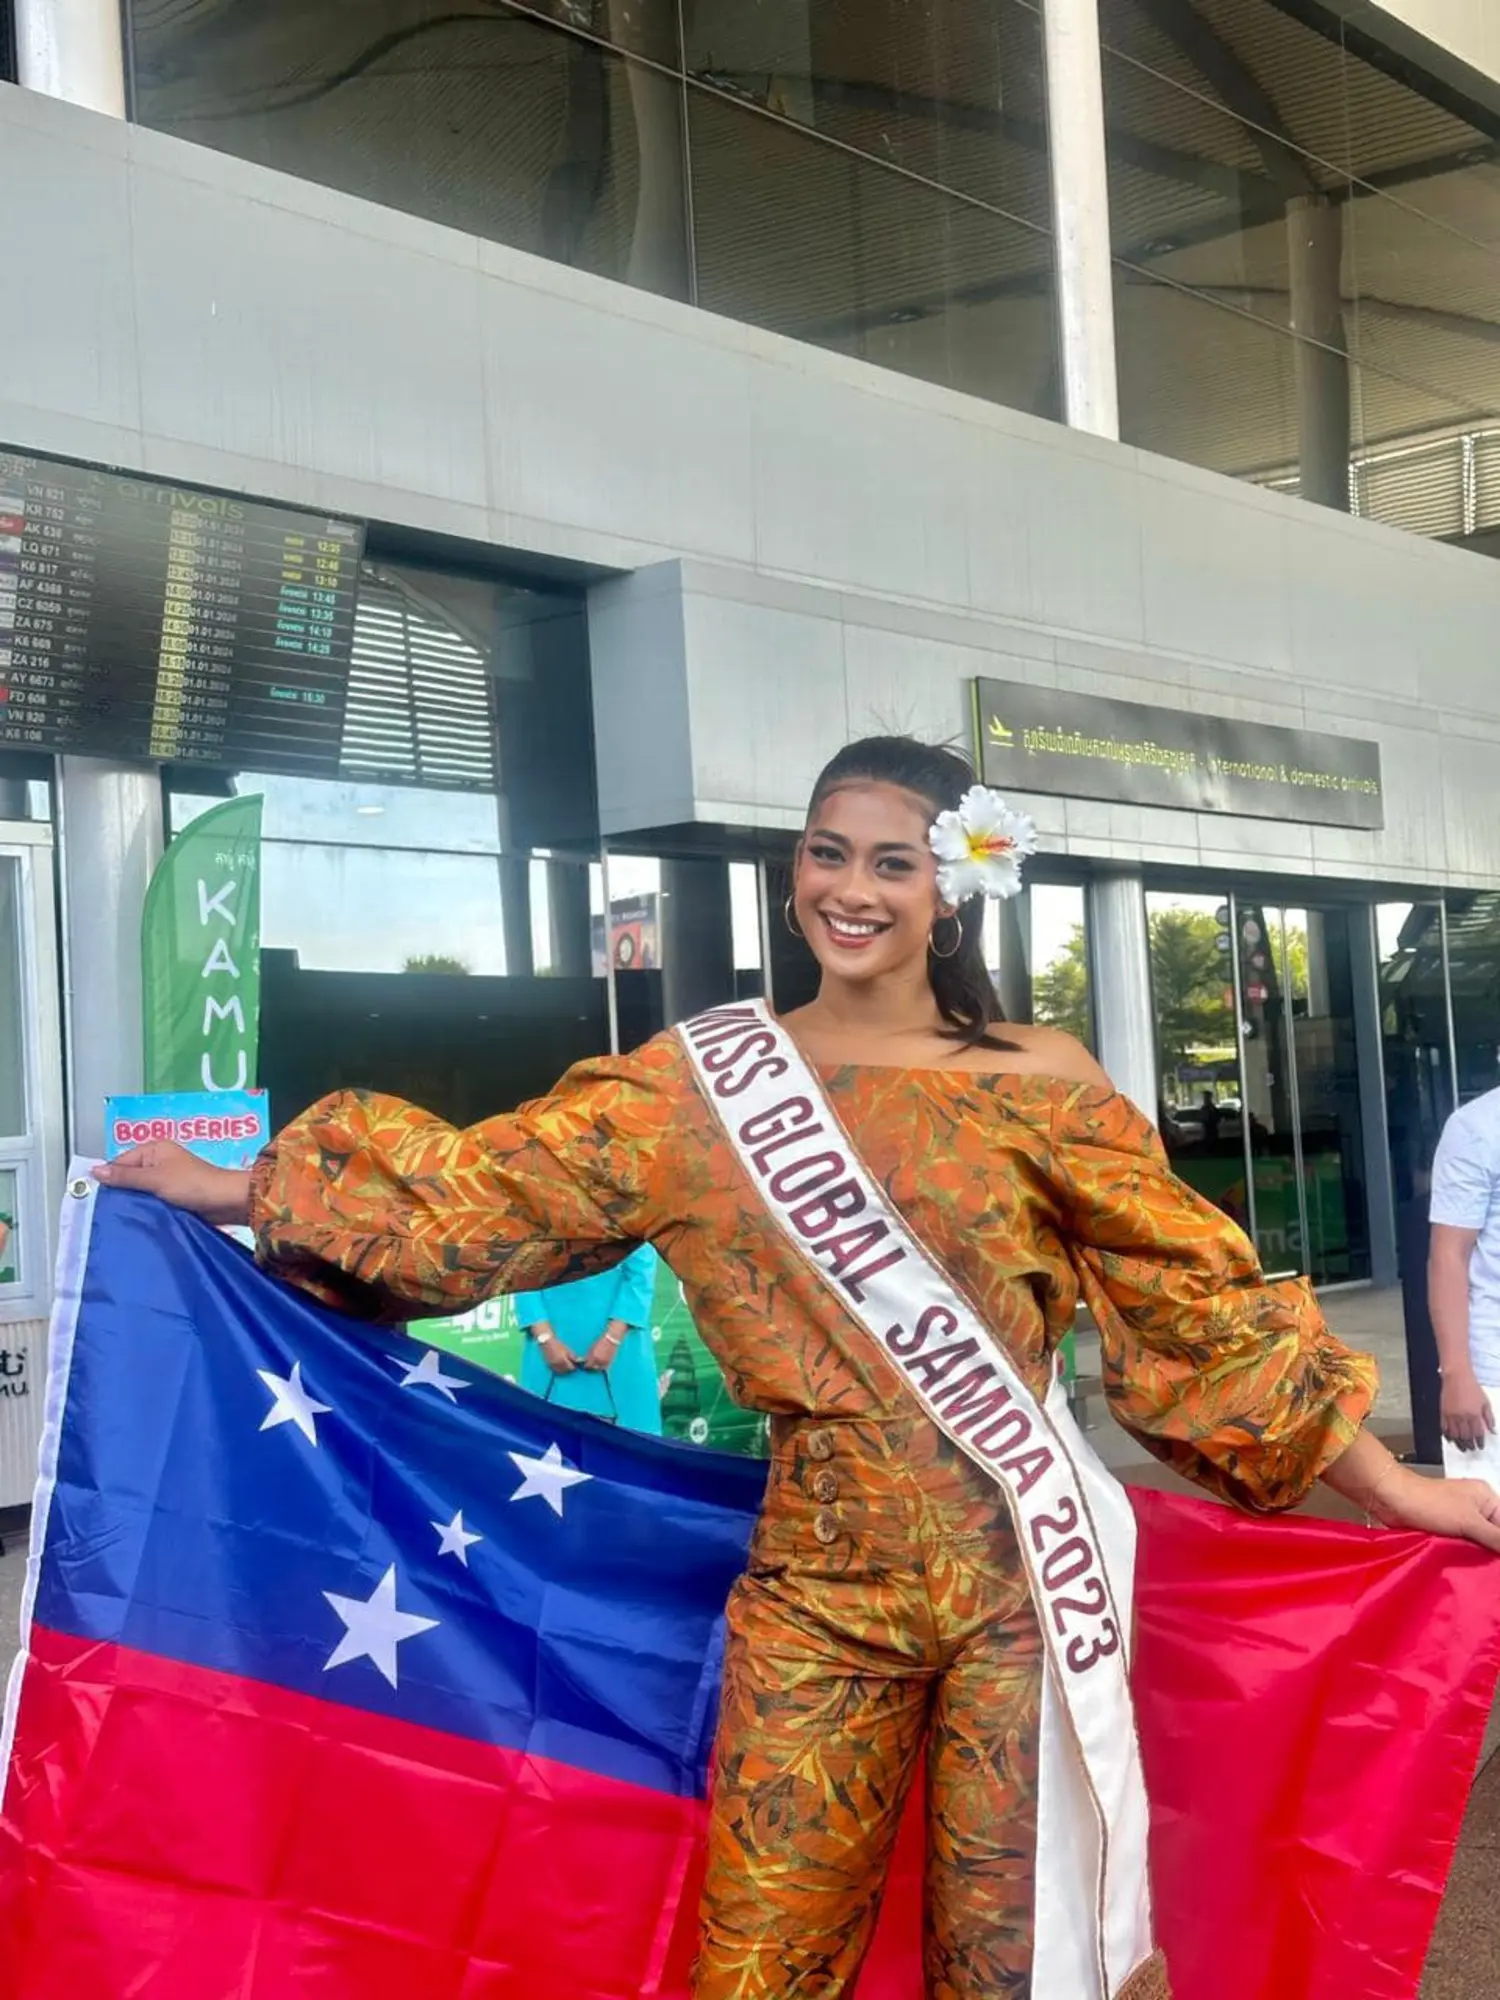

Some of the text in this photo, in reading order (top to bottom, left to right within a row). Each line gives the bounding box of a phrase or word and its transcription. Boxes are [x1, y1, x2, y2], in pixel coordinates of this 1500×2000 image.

[117, 482, 245, 520] arrivals
[11, 672, 27, 683] AY
[9, 690, 25, 702] FD
[1291, 767, 1339, 791] domestic
[197, 878, 248, 1092] KAMU
[115, 1114, 261, 1143] BOBI SERIES
[686, 1008, 1119, 1673] MISS GLOBAL SAMOA 2023
